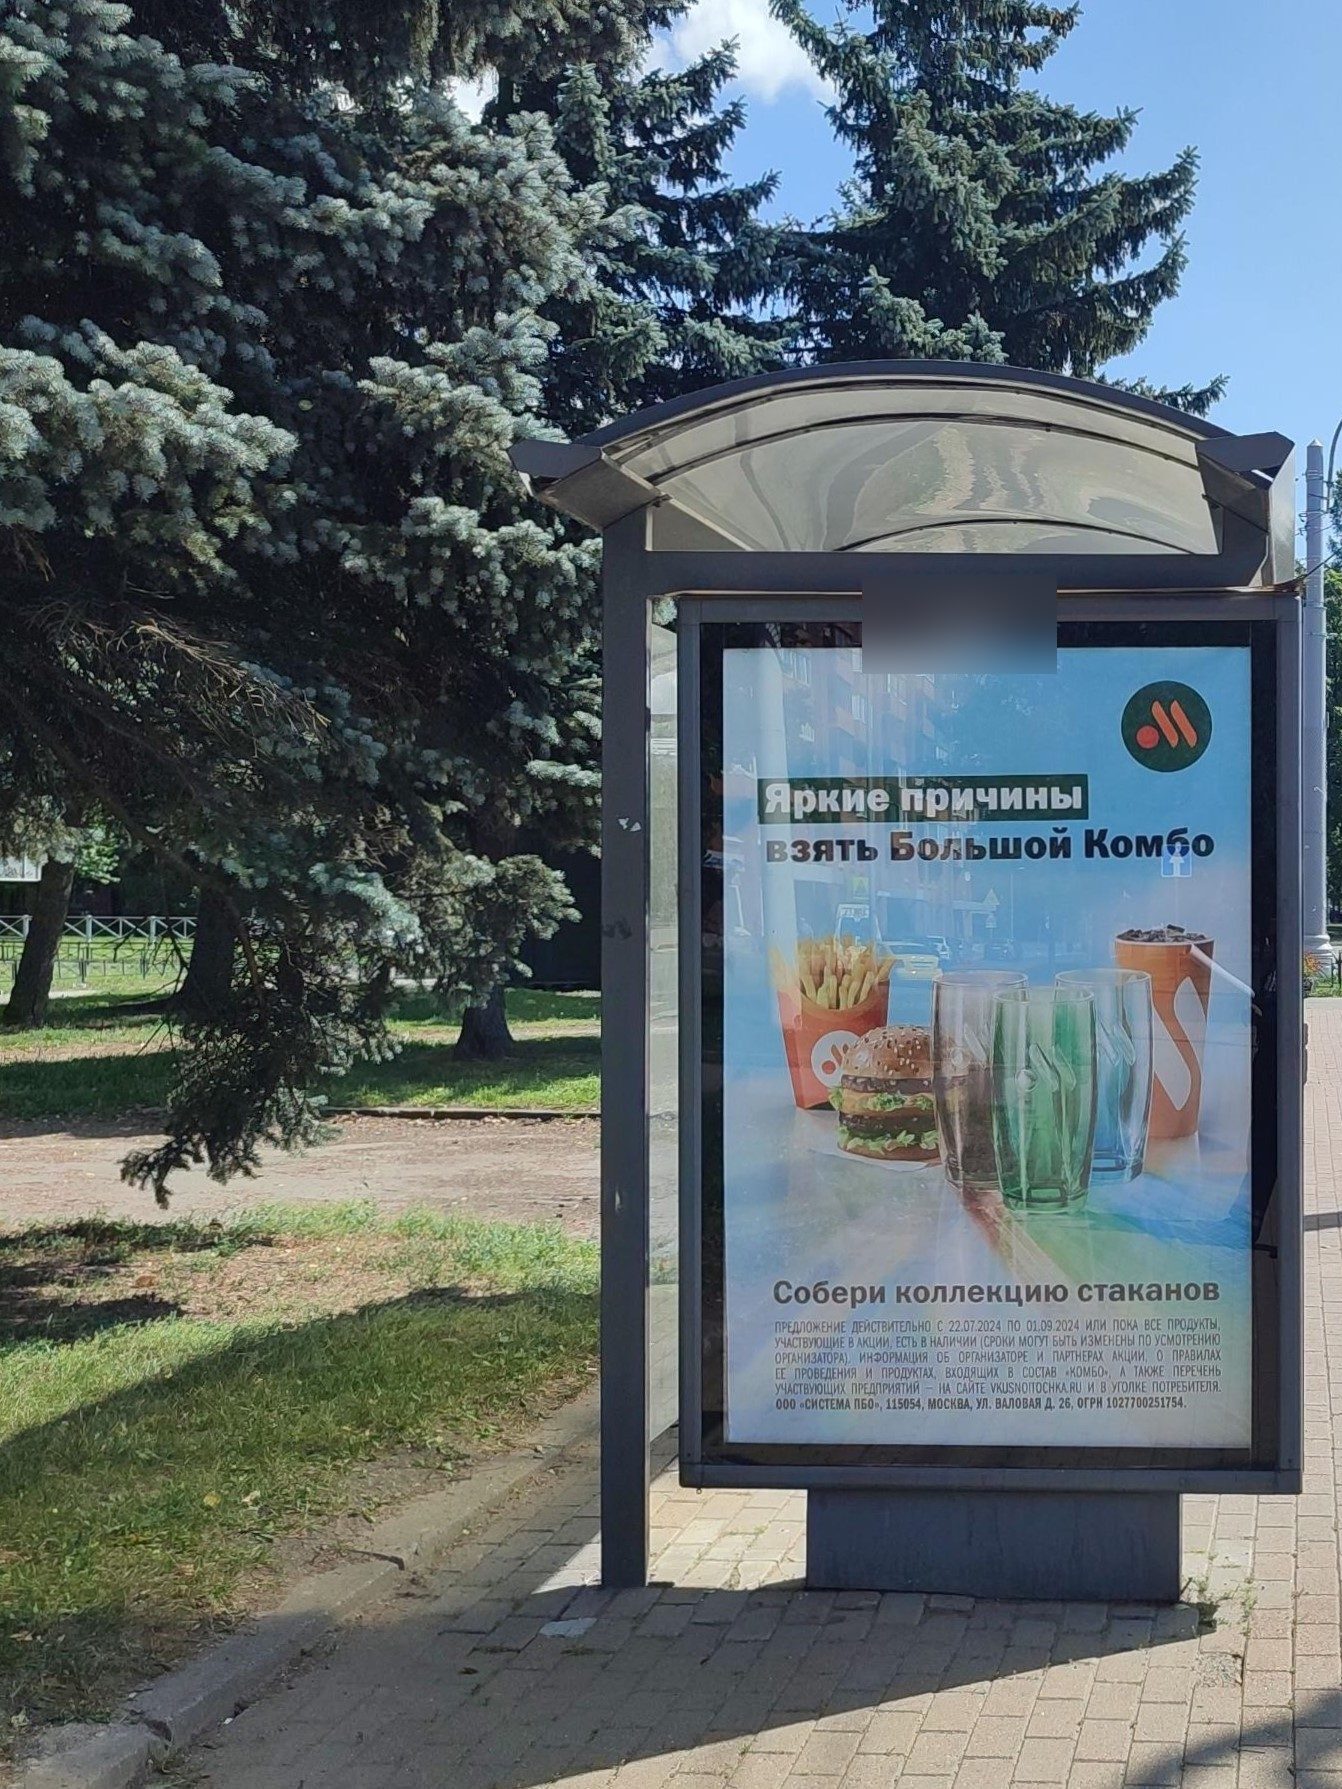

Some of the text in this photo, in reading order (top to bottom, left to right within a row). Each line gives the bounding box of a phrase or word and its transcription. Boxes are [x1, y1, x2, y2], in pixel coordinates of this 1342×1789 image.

[764, 783, 1083, 820] Яркие причины
[766, 827, 1214, 863] взять Большой Комбо
[773, 1280, 1220, 1308] Собери коллекцию стаканов
[775, 1321, 846, 1335] ПРЕДЛОЖЕНИЕ
[852, 1319, 931, 1334] ДЕЙСТВИТЕЛЬНО
[937, 1321, 943, 1332] С
[949, 1320, 1000, 1332] 22.07.2024
[1008, 1320, 1020, 1332] ПО
[1026, 1320, 1079, 1332] 01.09.2024
[1086, 1320, 1106, 1331] ИЛИ
[1113, 1319, 1138, 1331] ПОКА
[1145, 1319, 1161, 1331] ВСЕ
[775, 1336, 844, 1351] УЧАСТВУЮЩИЕ
[849, 1336, 854, 1348] В
[896, 1336, 917, 1348] ЕСТЬ
[921, 1336, 927, 1347] В
[930, 1336, 976, 1348] НАЛИЧИИ
[980, 1335, 1015, 1349] (СРОКИ
[1019, 1335, 1049, 1347] МОГУТ
[1053, 1335, 1077, 1347] БЫТЬ
[1081, 1335, 1135, 1346] ИЗМЕНЕНЫ
[1139, 1334, 1150, 1346] ПО
[1155, 1334, 1220, 1346] УСМОТРЕНИЮ
[859, 1351, 928, 1365] ИНФОРМАЦИЯ
[937, 1351, 949, 1363] ОБ
[959, 1351, 1028, 1363] ОРГАНИЗАТОРЕ
[1037, 1351, 1043, 1362] И
[1052, 1350, 1103, 1362] ПАРТНЕРАХ
[1157, 1350, 1163, 1362] О
[1172, 1349, 1221, 1362] ПРАВИЛАХ
[776, 1368, 786, 1379] ЕЕ
[795, 1367, 856, 1382] ПРОВЕДЕНИЯ
[866, 1367, 872, 1379] И
[946, 1366, 998, 1381] ВХОДЯЩИХ
[1008, 1366, 1013, 1378] В
[1022, 1366, 1057, 1378] СОСТАВ
[1120, 1366, 1125, 1377] А
[1134, 1365, 1164, 1377] ТАКЖЕ
[1173, 1365, 1221, 1377] ПЕРЕЧЕНЬ
[775, 1383, 845, 1397] УЧАСТВУЮЩИХ
[852, 1381, 920, 1397] ПРЕДПРИЯТИЙ
[938, 1382, 950, 1394] НА
[956, 1381, 985, 1394] САЙТЕ
[991, 1381, 1082, 1394] VKUSNOITOCHKA.RU
[1088, 1381, 1094, 1393] И
[1100, 1381, 1106, 1392] В
[1112, 1381, 1146, 1392] УГОЛКЕ
[1152, 1381, 1221, 1393] ПОТРЕБИТЕЛЯ.
[776, 1397, 1187, 1412] ООО «СИСТЕМА ПБО», 115054, МОСКВА, УЛ. ВАЛОВАЯ Д. 26, ОГРН 1027700251754.
